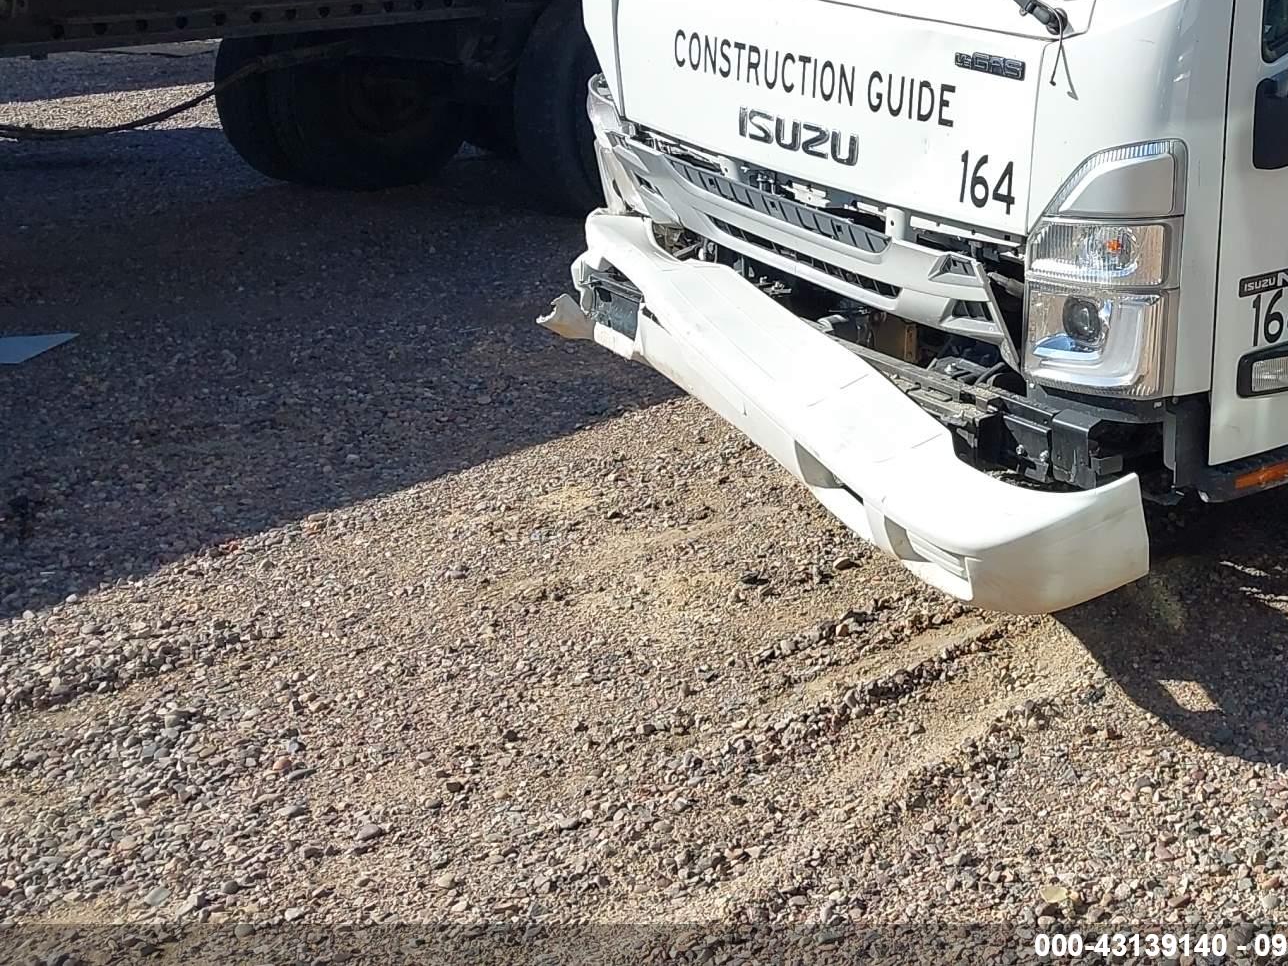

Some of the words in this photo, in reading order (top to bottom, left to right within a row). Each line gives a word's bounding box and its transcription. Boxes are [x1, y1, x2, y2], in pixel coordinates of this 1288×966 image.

[674, 29, 856, 107] CONSTRUCTION
[867, 70, 957, 128] GUIDE
[972, 51, 1026, 82] GAS
[738, 106, 860, 167] ISUZU
[959, 149, 1016, 216] 164
[1243, 276, 1277, 293] ISUZU
